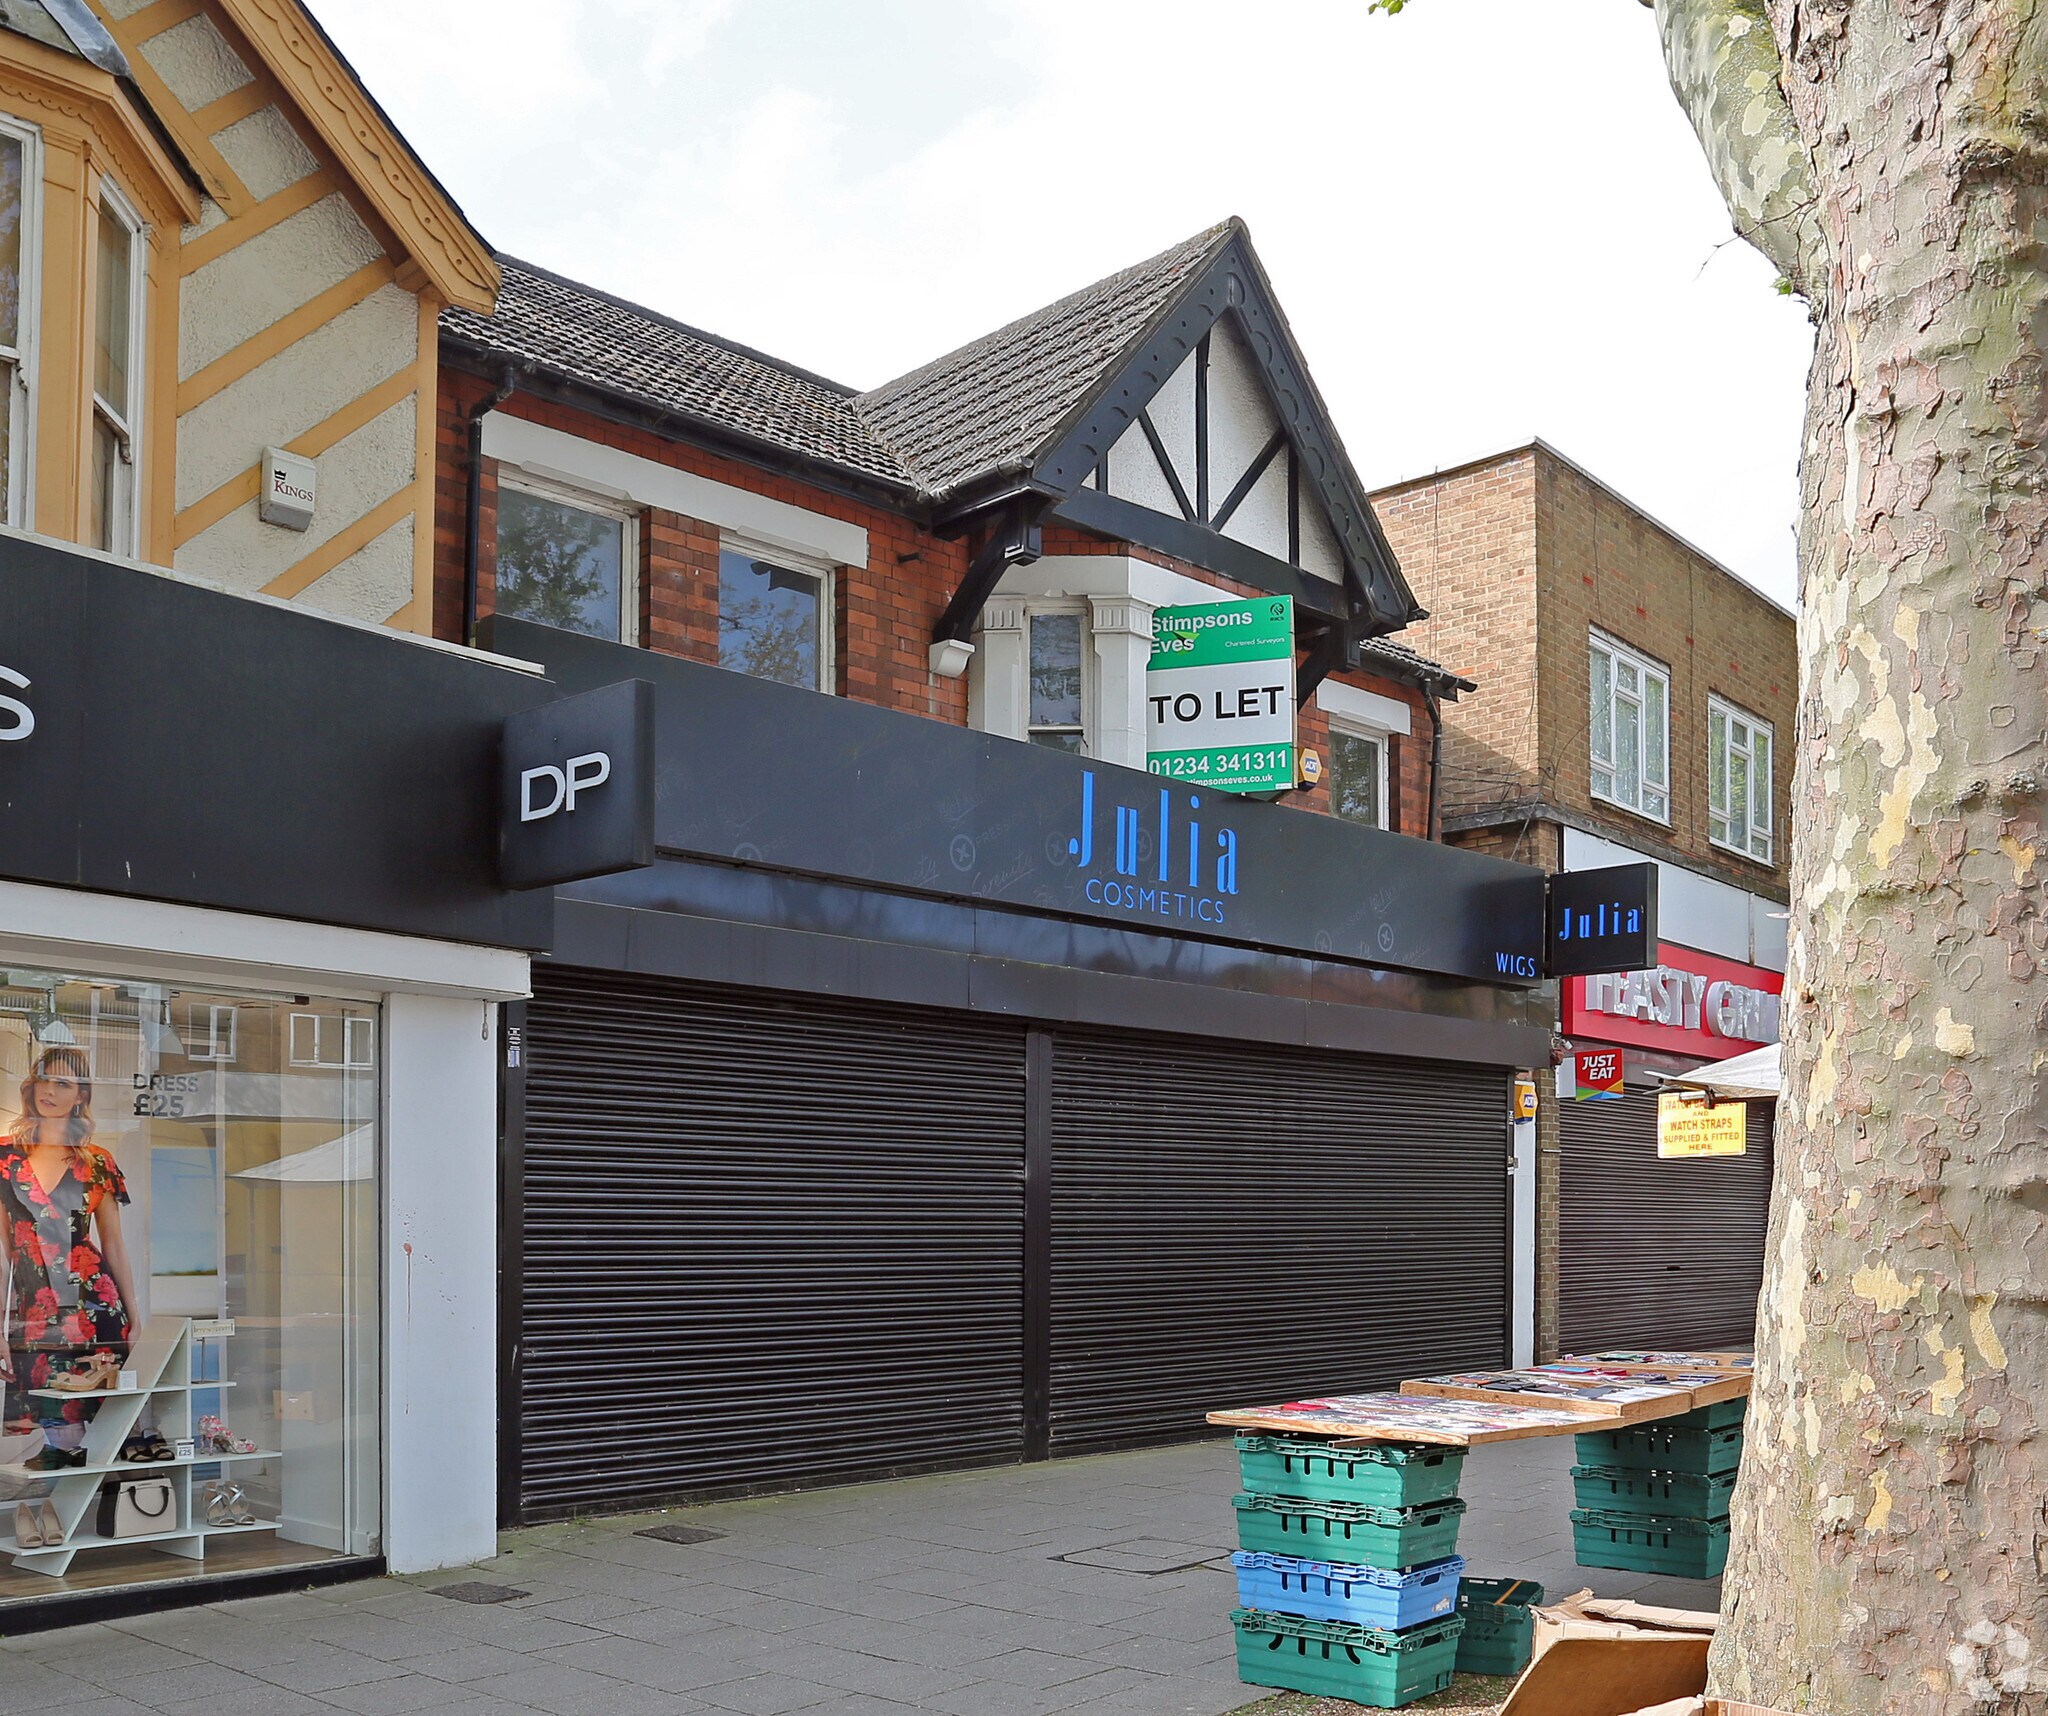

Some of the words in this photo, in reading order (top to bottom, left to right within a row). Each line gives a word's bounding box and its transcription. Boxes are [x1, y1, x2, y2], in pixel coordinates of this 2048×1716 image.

[274, 480, 313, 502] KINGS
[1152, 612, 1253, 633] Stimpsons
[1151, 638, 1195, 654] Eves
[1225, 639, 1255, 647] Chartered
[1256, 637, 1285, 645] Surveyors
[1149, 692, 1202, 724] TO
[1215, 686, 1285, 720] LET
[1150, 755, 1210, 775] 01234
[1216, 750, 1287, 772] 341311
[521, 752, 610, 821] DP
[1069, 770, 1239, 895] Julia
[1085, 878, 1225, 924] COSMETICS
[1558, 902, 1640, 941] Julia
[1495, 952, 1536, 977] WIGS
[1582, 1054, 1616, 1071] JUST
[133, 1073, 199, 1093] DRESS
[1589, 1066, 1616, 1081] EAT
[133, 1093, 184, 1117] £25
[1670, 1120, 1698, 1131] WATCH
[1700, 1117, 1733, 1130] STRAPS
[1664, 1133, 1701, 1144] SUPPLIED
[1711, 1131, 1740, 1141] FITTED
[1688, 1143, 1713, 1151] HERE
